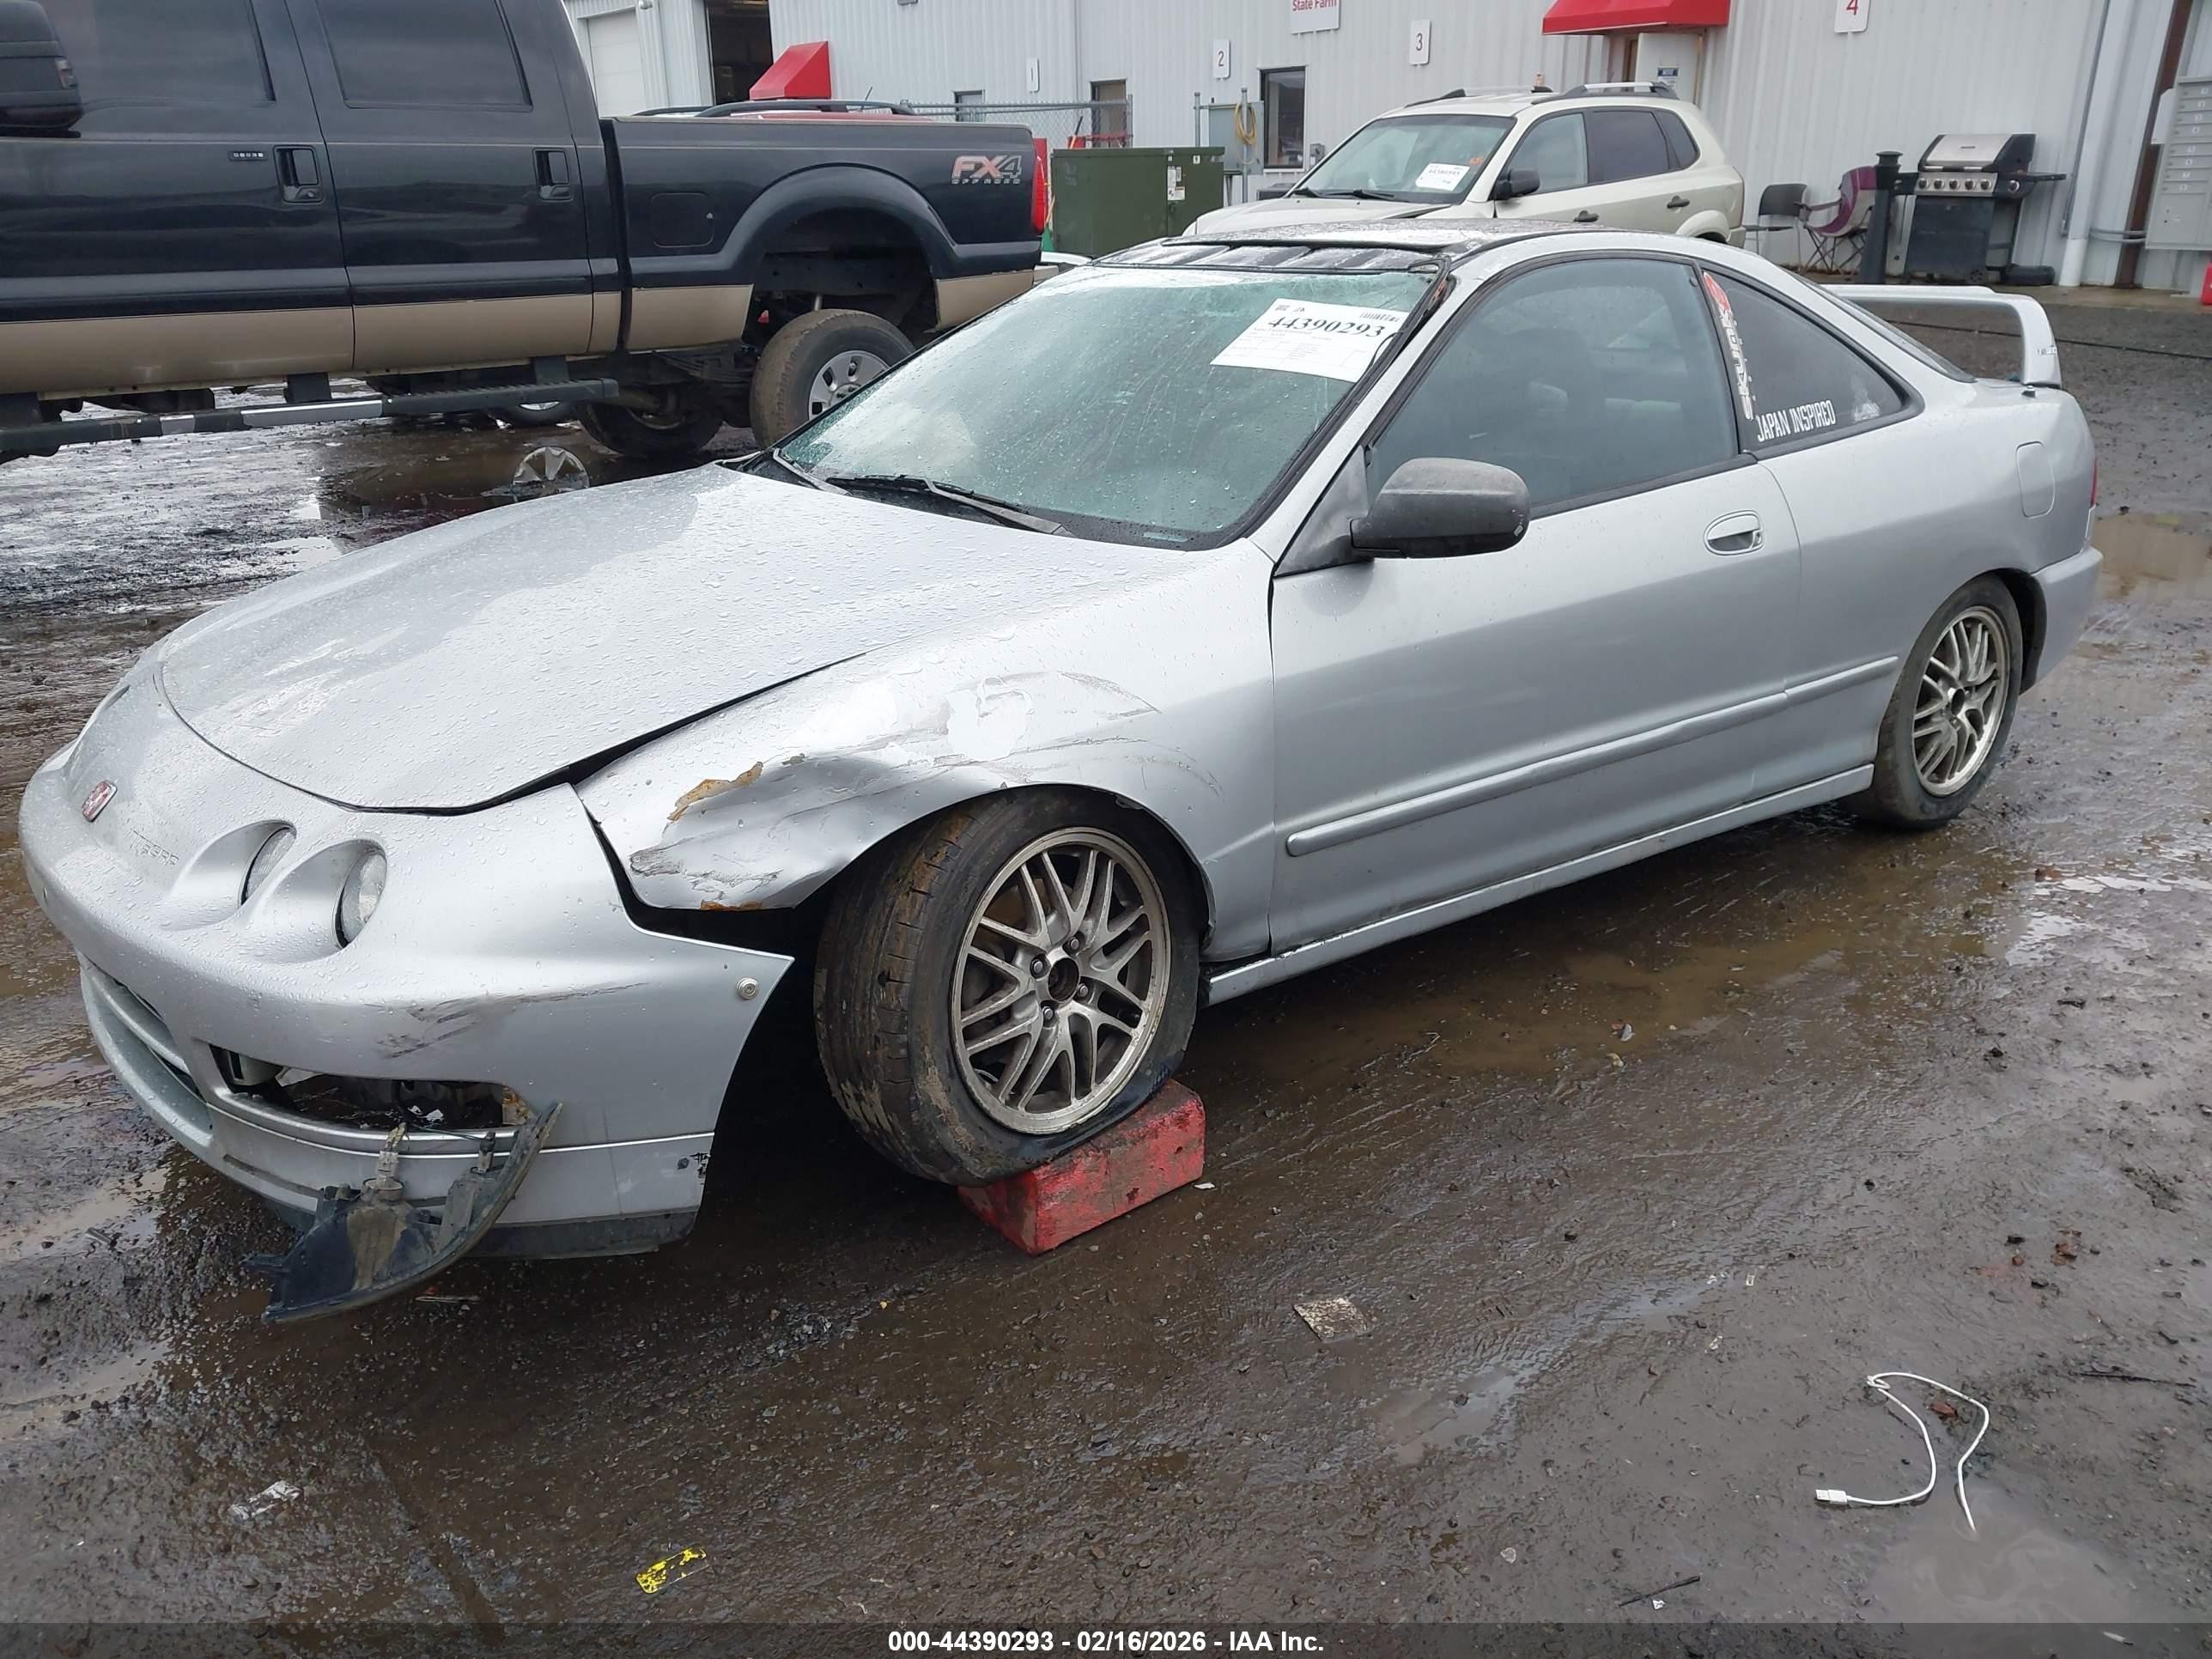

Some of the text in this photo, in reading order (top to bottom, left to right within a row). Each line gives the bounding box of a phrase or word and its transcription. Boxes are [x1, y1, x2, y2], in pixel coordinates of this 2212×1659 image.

[1291, 0, 1313, 11] State
[1846, 0, 1859, 15] 4
[1416, 33, 1423, 52] 3
[1218, 50, 1224, 67] 2
[951, 155, 1022, 179] FX4
[1267, 315, 1386, 337] 44390293
[1755, 399, 1837, 442] JAPAN INSPIRED
